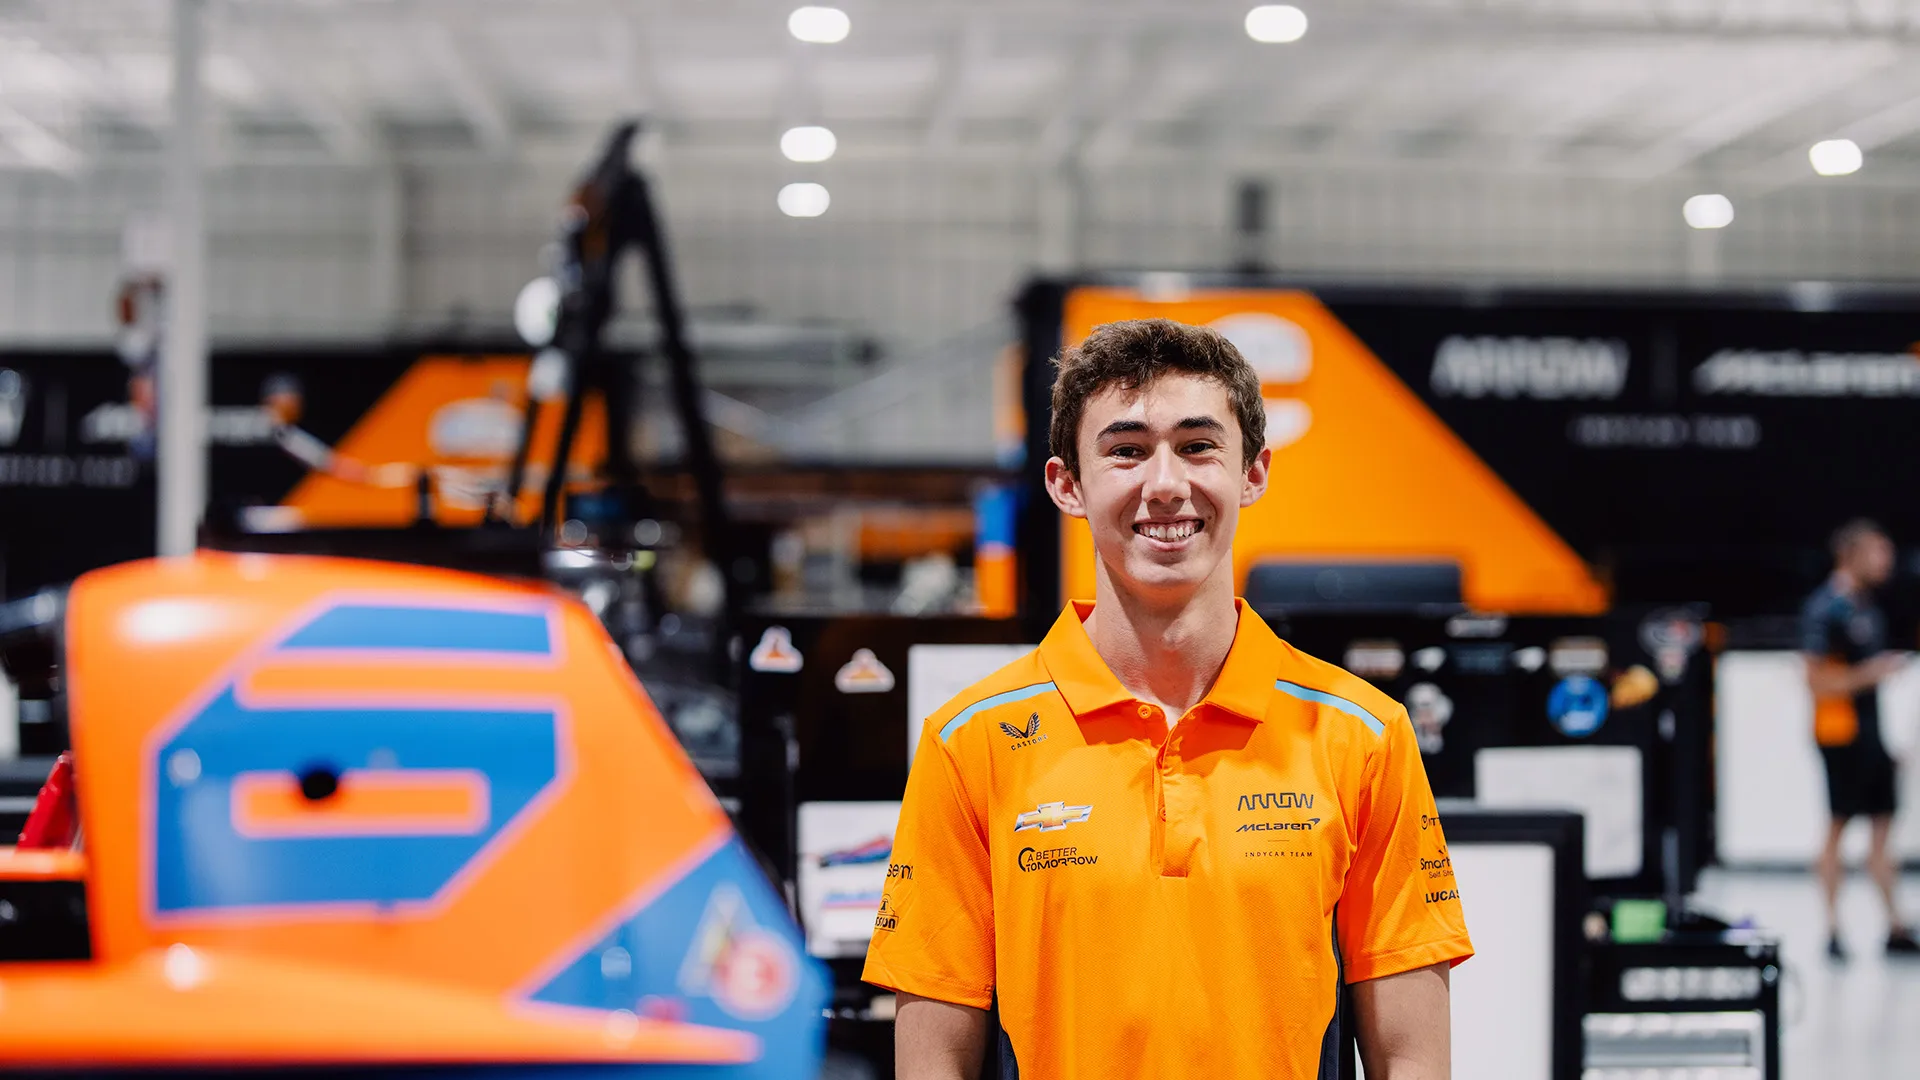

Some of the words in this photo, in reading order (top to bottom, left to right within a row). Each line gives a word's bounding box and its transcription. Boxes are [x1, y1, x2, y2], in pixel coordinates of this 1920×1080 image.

[1011, 734, 1048, 751] CASTORE
[1238, 792, 1314, 811] ARROW
[1236, 822, 1312, 832] McLaren
[1027, 854, 1034, 862] A
[1037, 847, 1077, 860] BETTER
[1026, 855, 1098, 872] TOMORROW
[1420, 856, 1450, 870] Smart
